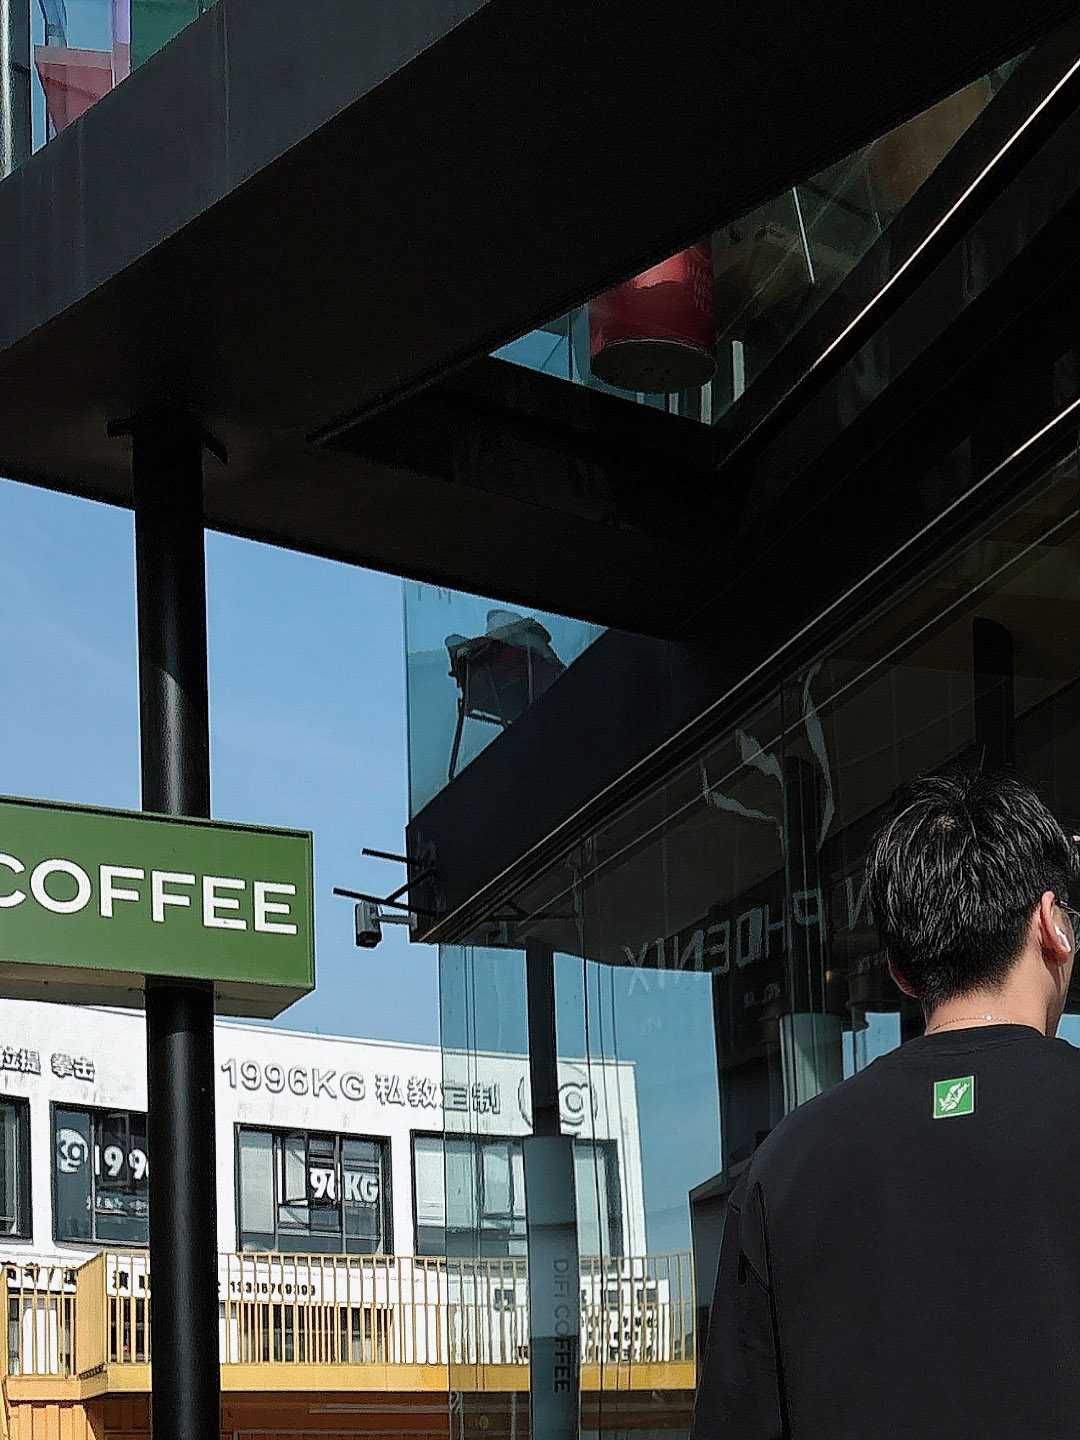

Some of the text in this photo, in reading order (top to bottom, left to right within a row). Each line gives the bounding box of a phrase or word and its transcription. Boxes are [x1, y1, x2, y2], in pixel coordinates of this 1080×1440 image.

[0, 852, 298, 935] COFFEE
[221, 1058, 366, 1101] 1996KG
[554, 1304, 571, 1393] COFFEE
